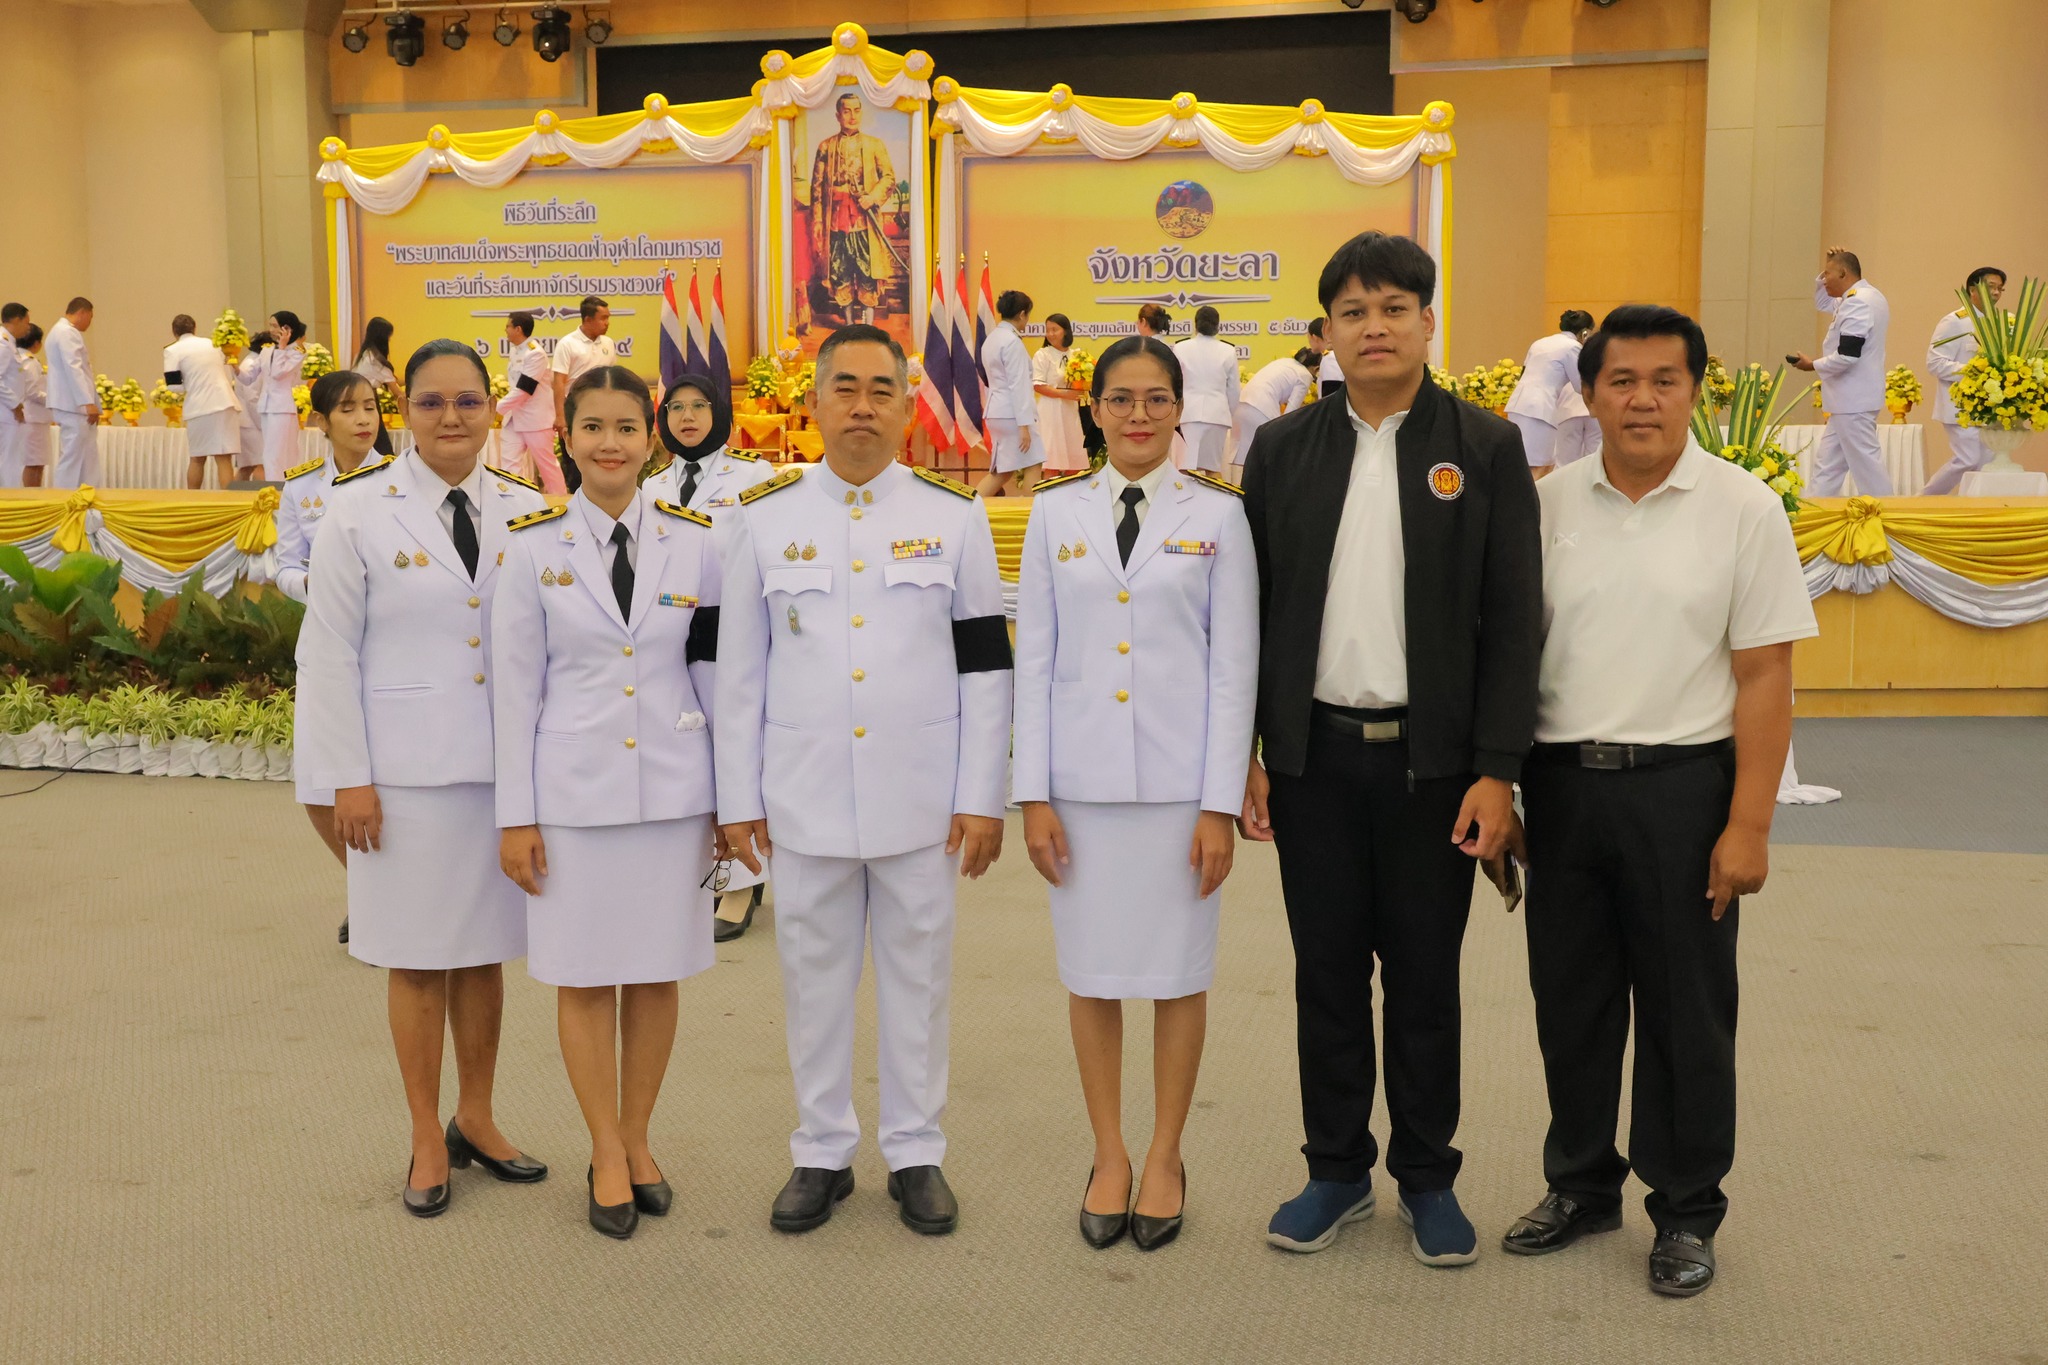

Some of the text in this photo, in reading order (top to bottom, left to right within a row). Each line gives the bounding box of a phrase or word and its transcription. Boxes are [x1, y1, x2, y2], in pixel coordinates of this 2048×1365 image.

[504, 197, 596, 222] พิธีวันที่ระลึก
[1088, 246, 1278, 281] จังหวัดยะลา
[475, 338, 490, 355] ๖
